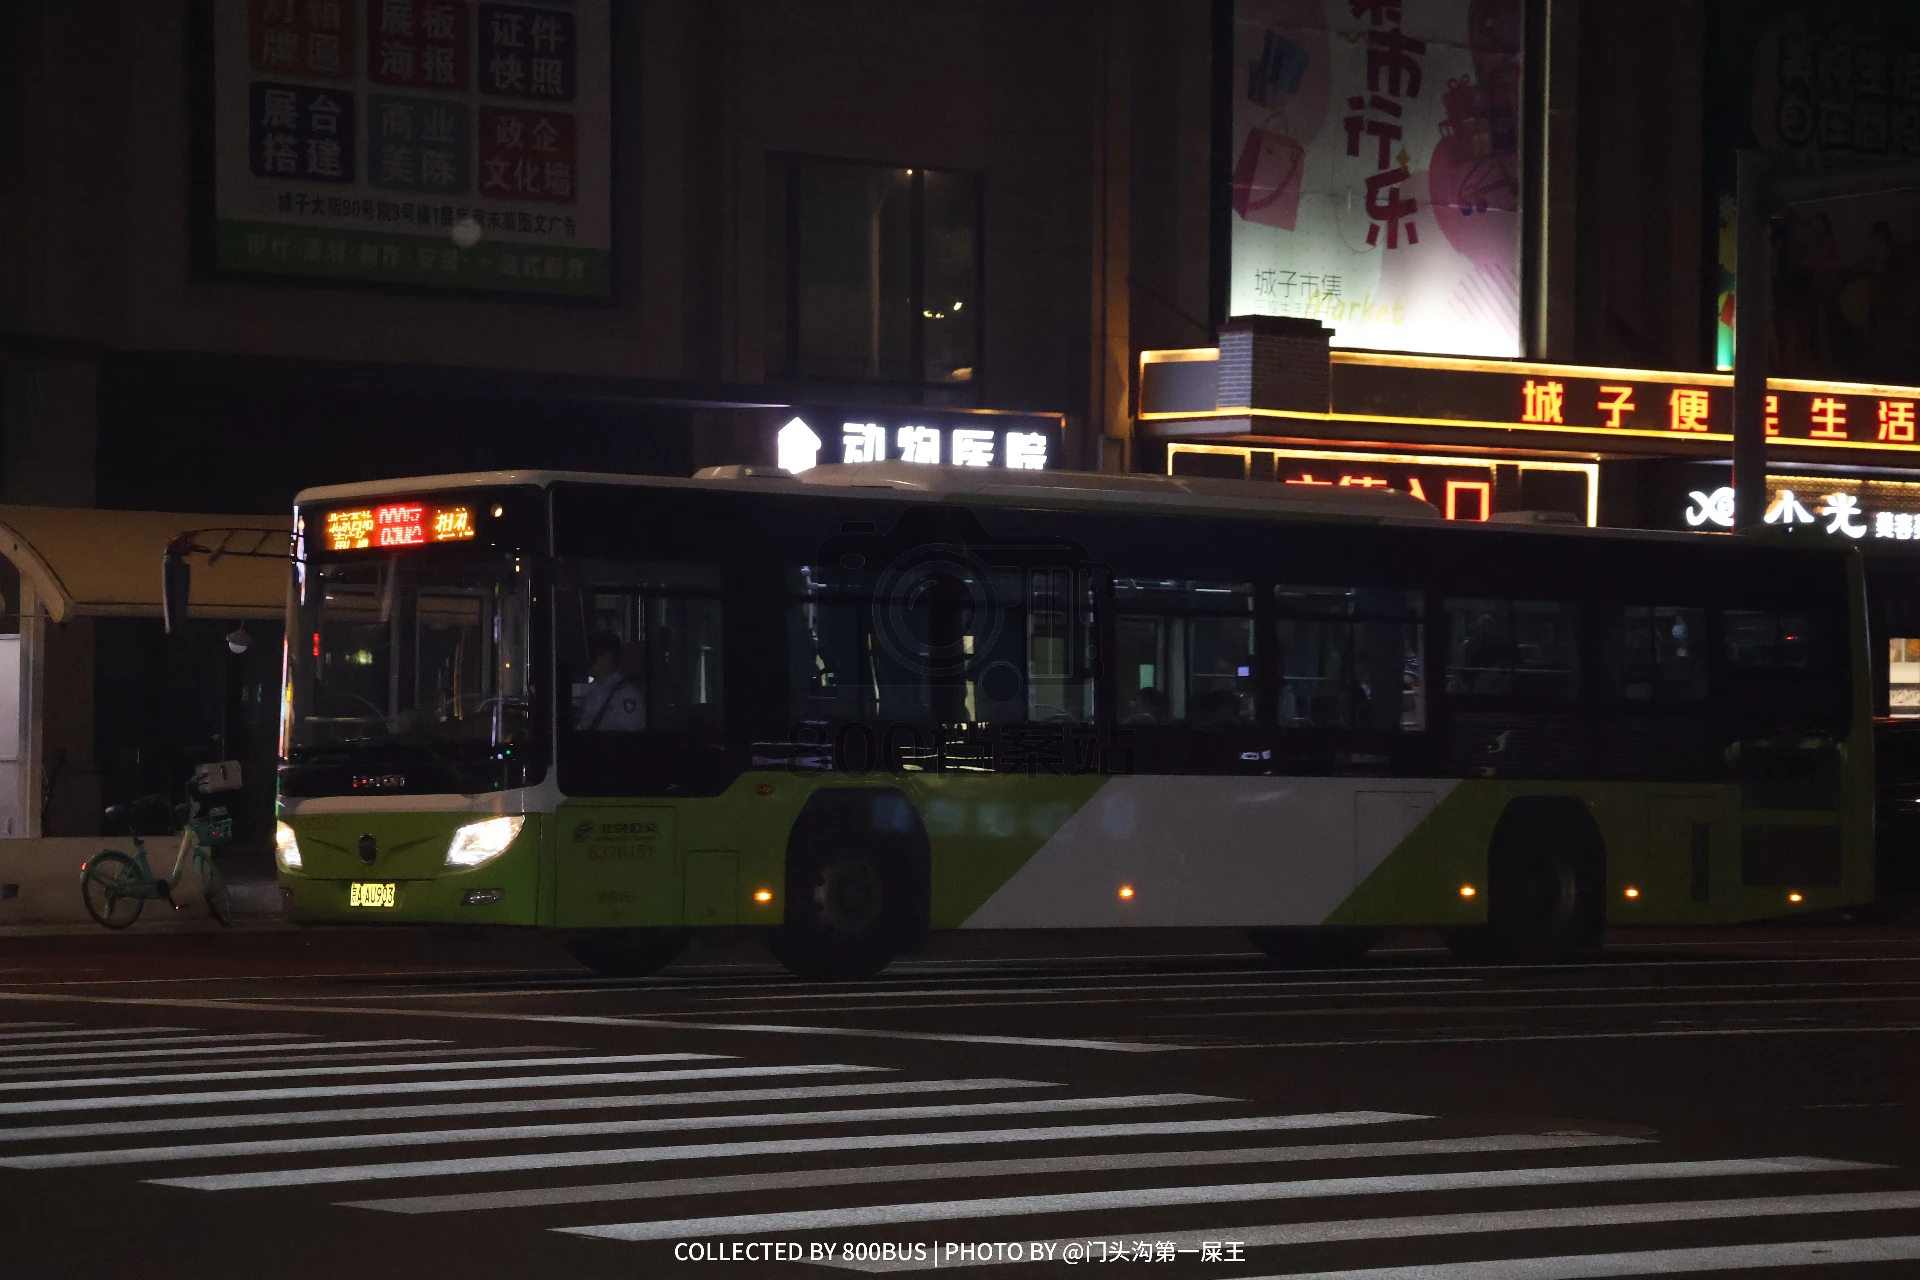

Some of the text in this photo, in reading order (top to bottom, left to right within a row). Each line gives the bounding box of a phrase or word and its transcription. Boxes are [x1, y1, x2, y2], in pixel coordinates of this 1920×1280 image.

[381, 0, 455, 41] 展板
[489, 12, 565, 53] 证件
[380, 40, 456, 84] 海报
[489, 55, 565, 95] 快照
[261, 88, 342, 134] 展台
[382, 101, 456, 144] 商业
[261, 132, 342, 177] 搭建
[496, 115, 560, 153] 政企
[484, 157, 571, 197] 文化墙
[1254, 268, 1342, 301] 城子市集
[842, 422, 1048, 470] 动物医院
